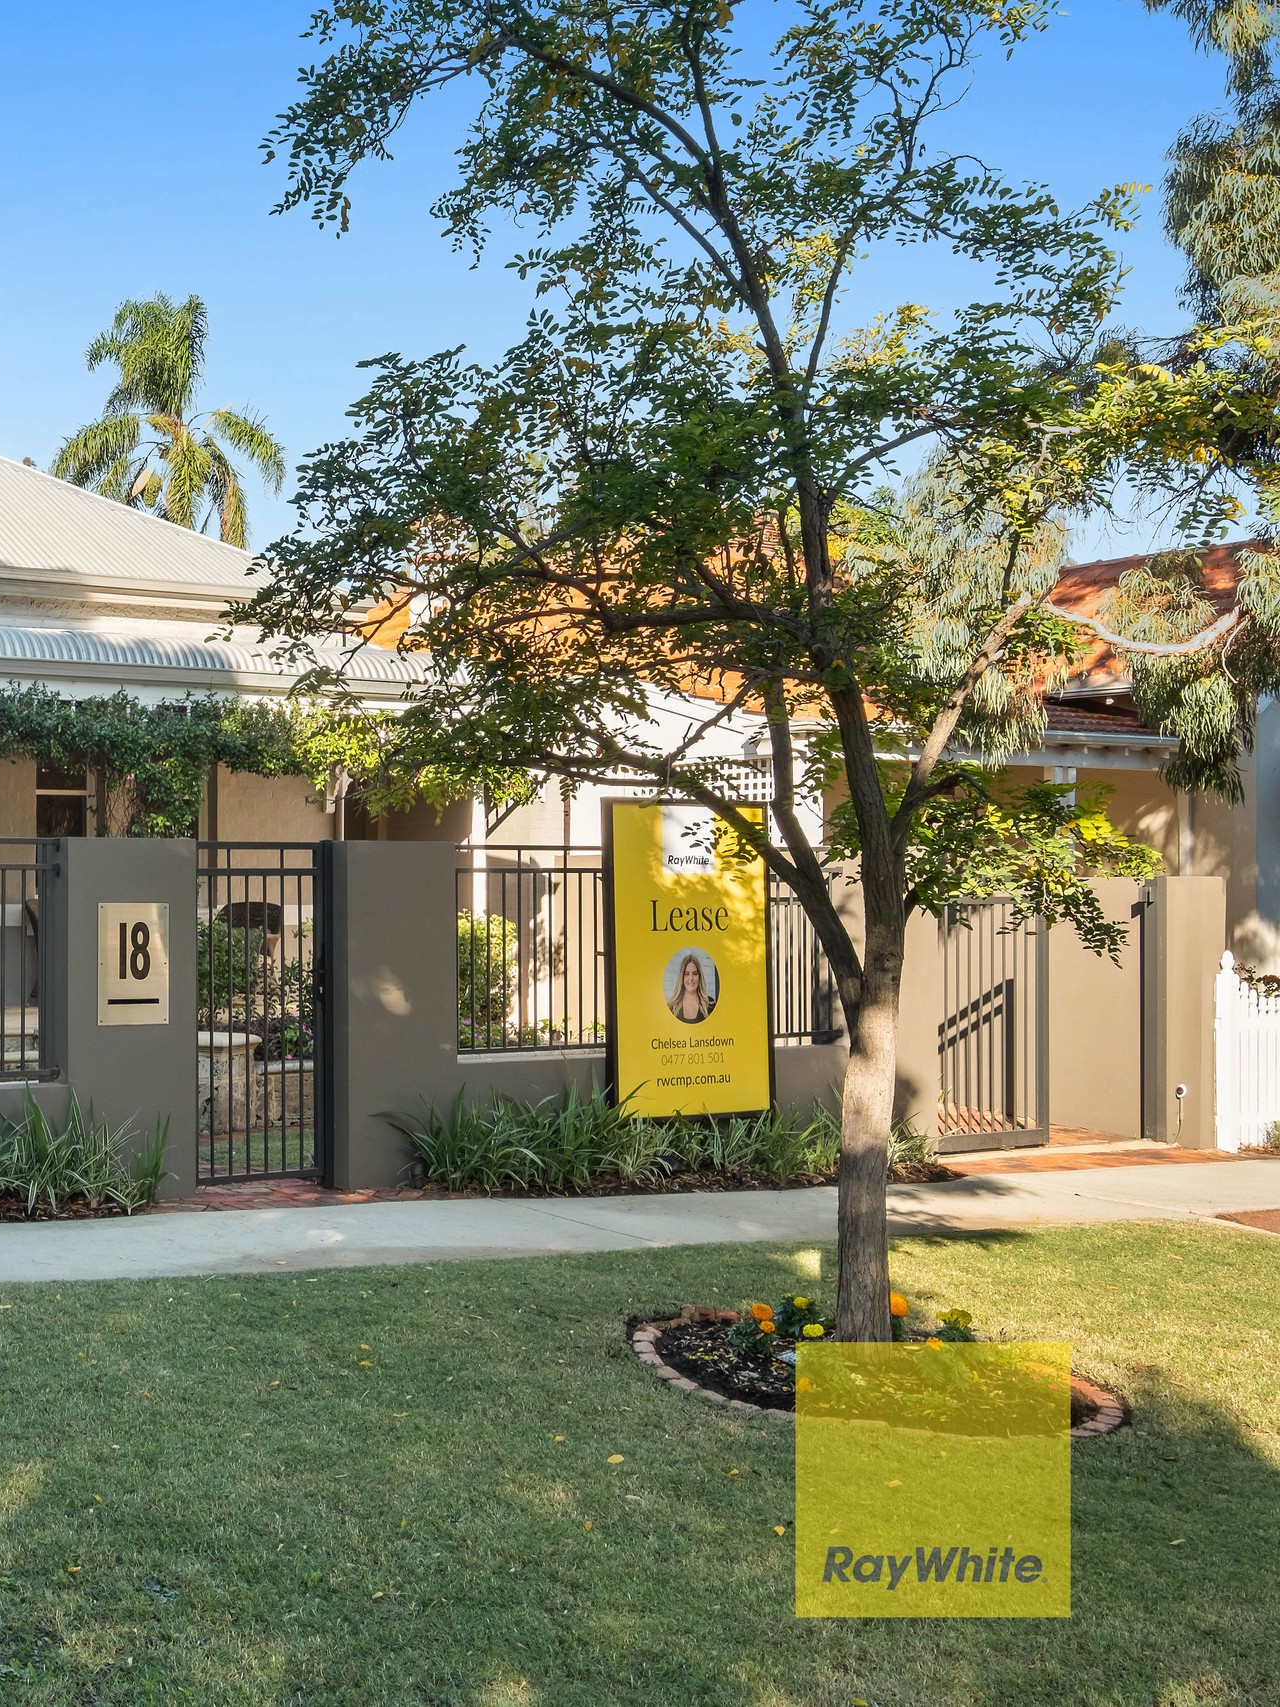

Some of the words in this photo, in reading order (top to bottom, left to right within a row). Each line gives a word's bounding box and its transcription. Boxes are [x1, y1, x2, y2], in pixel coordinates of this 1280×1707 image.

[650, 900, 729, 932] Lease
[119, 921, 151, 981] 18
[651, 1038, 687, 1050] Chelsea
[689, 1036, 734, 1048] Lansdown
[661, 1054, 686, 1066] 0477
[687, 1053, 705, 1065] 801
[707, 1051, 725, 1063] 501
[656, 1073, 731, 1088] rwcmp.com.au
